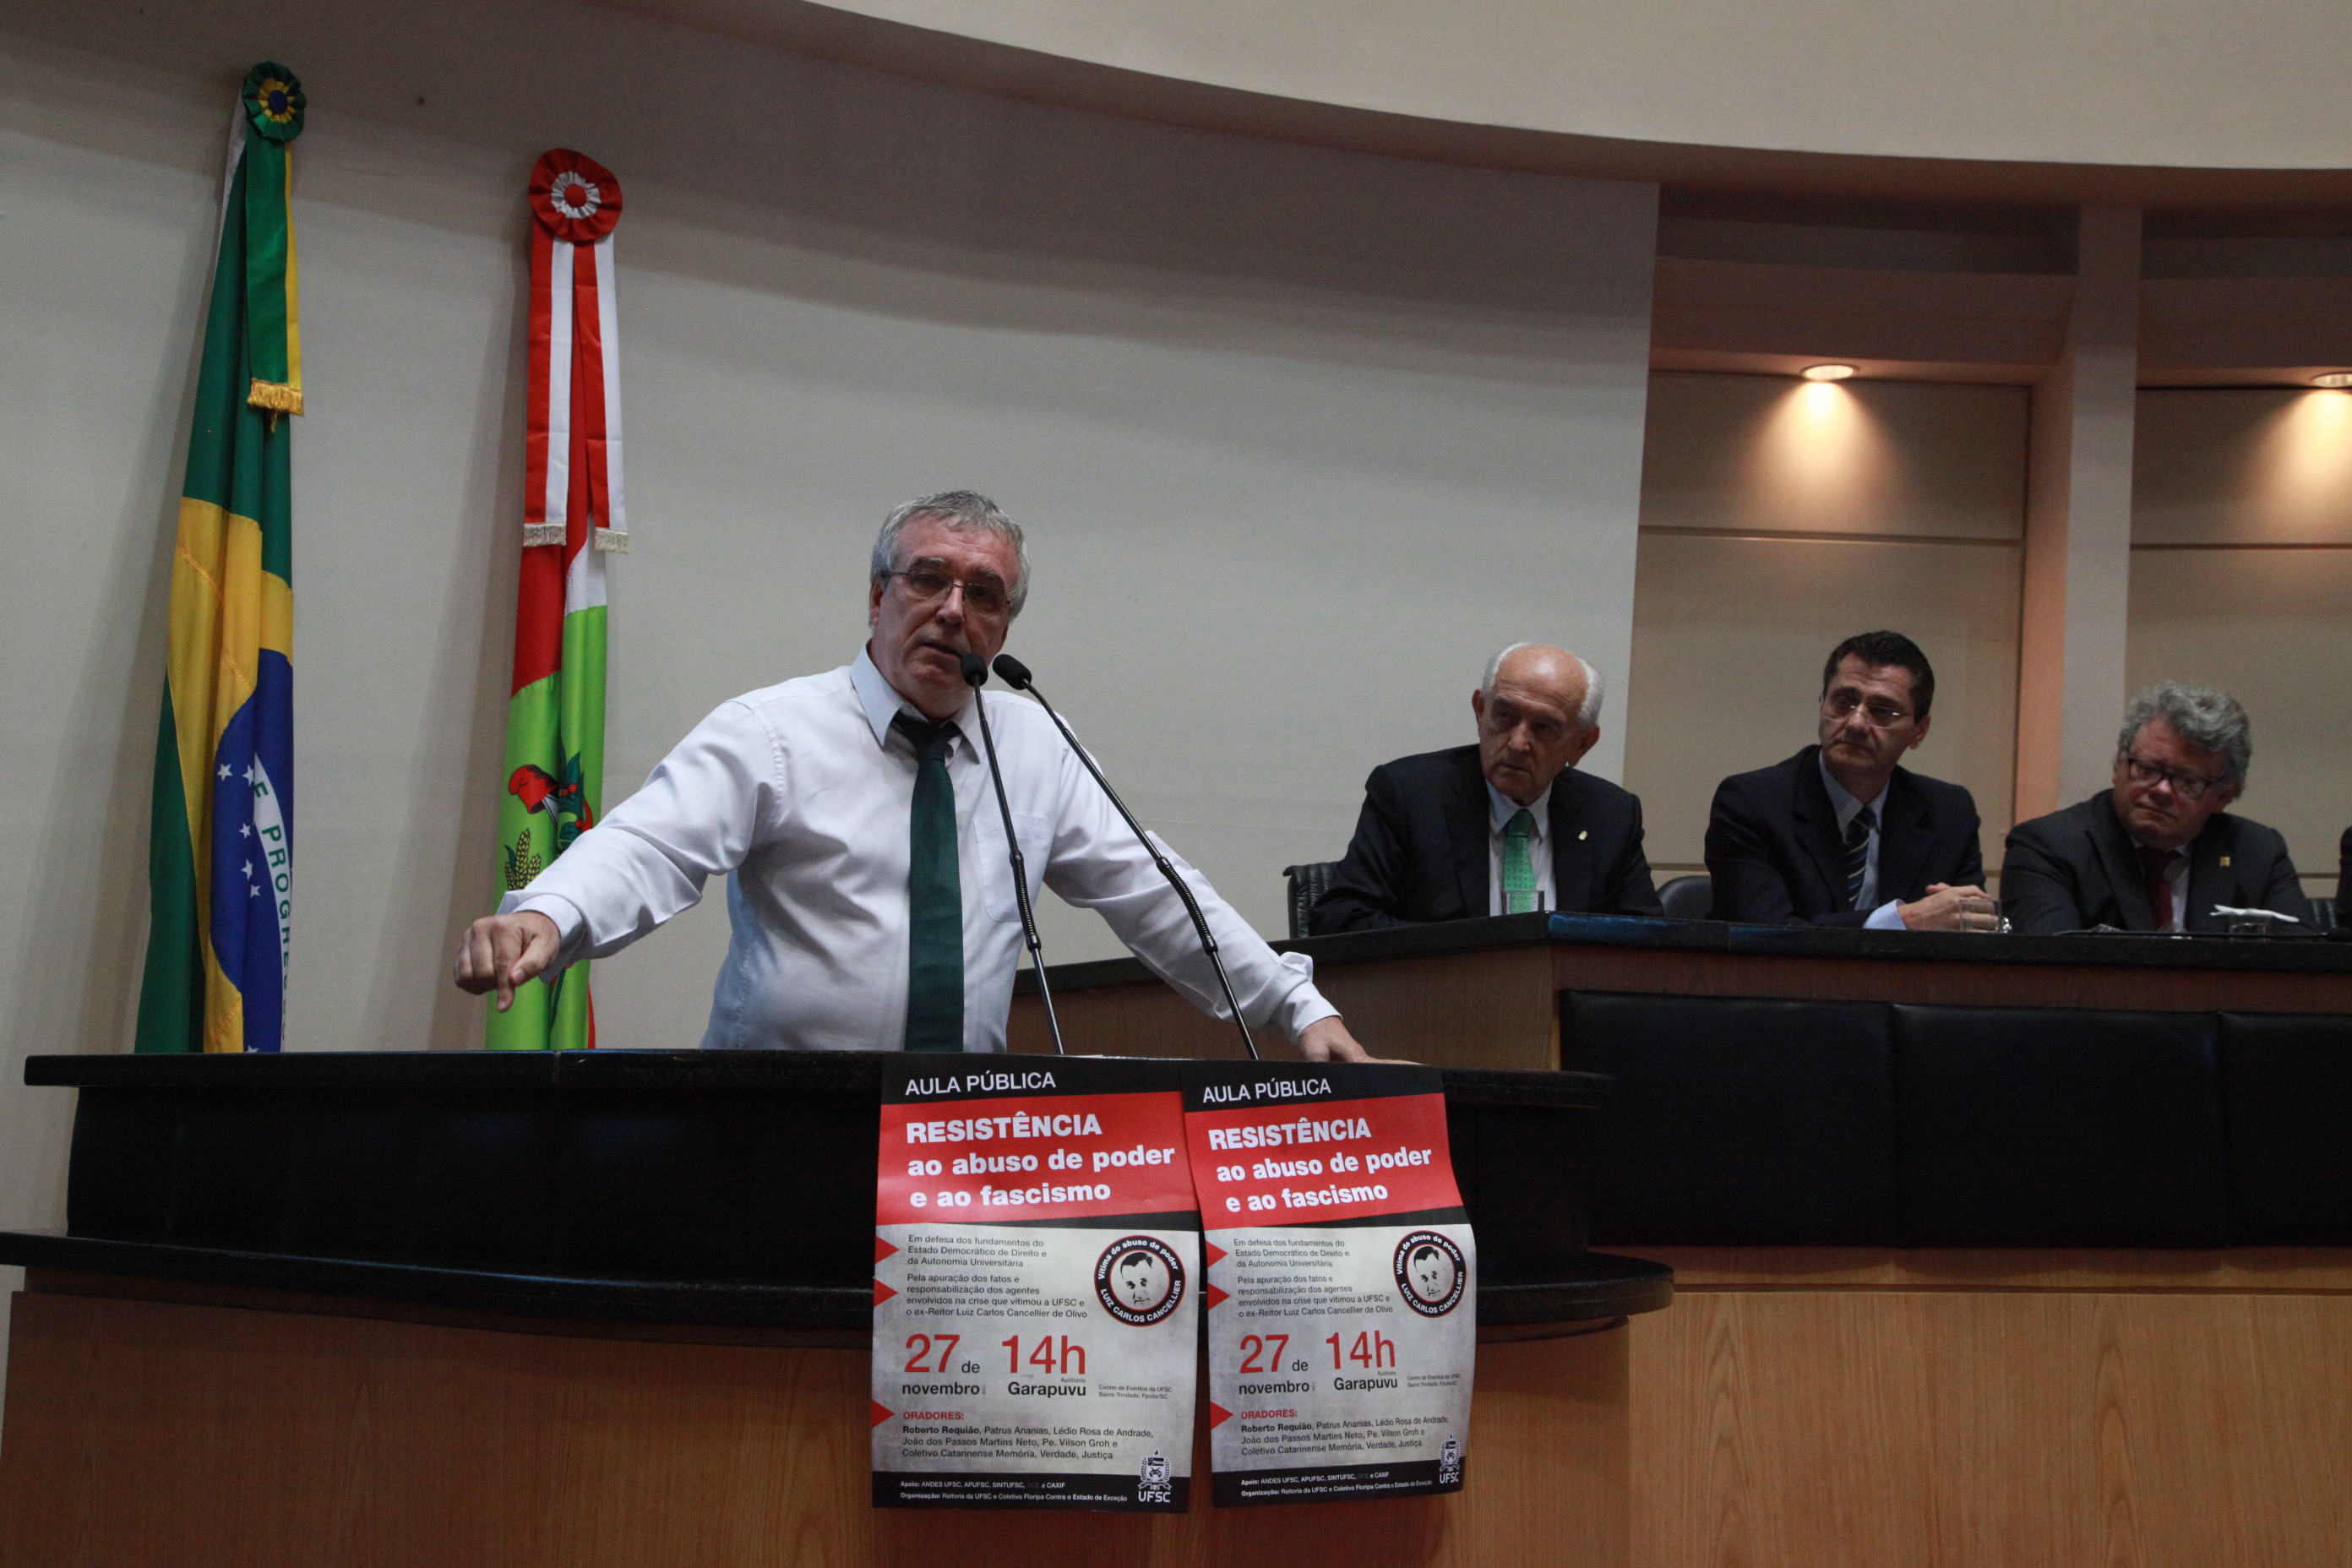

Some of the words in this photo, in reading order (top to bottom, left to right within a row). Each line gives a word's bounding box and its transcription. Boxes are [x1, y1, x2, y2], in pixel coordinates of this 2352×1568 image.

[254, 781, 269, 798] E
[906, 1076, 961, 1096] AULA
[967, 1070, 1056, 1092] PÚBLICA
[1203, 1085, 1250, 1103] AULA
[1255, 1078, 1331, 1099] PÚBLICA
[906, 1111, 1102, 1143] RESISTÊNCIA
[1208, 1118, 1372, 1150] RESISTÊNCIA
[907, 1159, 942, 1176] ao
[952, 1153, 1038, 1174] abuso
[1048, 1148, 1082, 1170] de
[1092, 1145, 1175, 1172] poder
[1217, 1165, 1245, 1182] ao
[1253, 1158, 1322, 1179] abuso
[1330, 1152, 1358, 1173] de
[1366, 1147, 1432, 1173] poder
[910, 1192, 927, 1207] e
[938, 1190, 971, 1206] ao
[980, 1183, 1111, 1206] fascismo
[1226, 1196, 1240, 1212] e
[1247, 1194, 1276, 1210] ao
[1282, 1184, 1388, 1207] fascismo
[925, 1235, 954, 1244] defesa
[975, 1238, 1030, 1246] fundamentos
[941, 1247, 995, 1255] Democrático
[1111, 1246, 1120, 1255] do
[1122, 1240, 1147, 1249] abuso
[1160, 1249, 1178, 1270] poder
[1443, 1241, 1460, 1261] poder
[921, 1257, 967, 1266] Autonomia
[971, 1258, 1023, 1267] Universitária
[928, 1275, 969, 1284] apuração
[907, 1286, 984, 1294] responsabilização
[1239, 1287, 1306, 1296] responsabilização
[1402, 1283, 1413, 1301] LUIZ
[1413, 1300, 1437, 1313] CARLOS
[1440, 1271, 1462, 1311] CANCELLIER
[992, 1298, 1007, 1308] que
[1101, 1288, 1113, 1307] LUIZ
[1113, 1306, 1145, 1322] CARLOS
[1147, 1280, 1181, 1321] CANCELLIER
[905, 1333, 960, 1373] 27
[961, 1361, 980, 1374] de
[1002, 1335, 1086, 1374] 14h
[1240, 1334, 1289, 1373] 27
[1293, 1359, 1309, 1371] de
[1326, 1331, 1396, 1369] 14h
[902, 1382, 979, 1395] novembro
[1008, 1382, 1086, 1398] Garapuvu
[1239, 1380, 1309, 1394] novembro
[1334, 1377, 1397, 1391] Garapuvu
[1241, 1409, 1298, 1419] ORADORES:
[942, 1426, 981, 1435] Requião,
[1015, 1427, 1050, 1435] Ananias,
[1117, 1429, 1153, 1438] Andrade,
[1278, 1423, 1314, 1431] Requião,
[1342, 1419, 1374, 1428] Ananias,
[902, 1449, 938, 1457] Coletivo
[996, 1450, 1037, 1458] Memória,
[1040, 1451, 1079, 1459] Verdade,
[1081, 1451, 1113, 1460] Justiça
[1440, 1472, 1459, 1484] UFSC
[1138, 1491, 1171, 1502] UFSC
